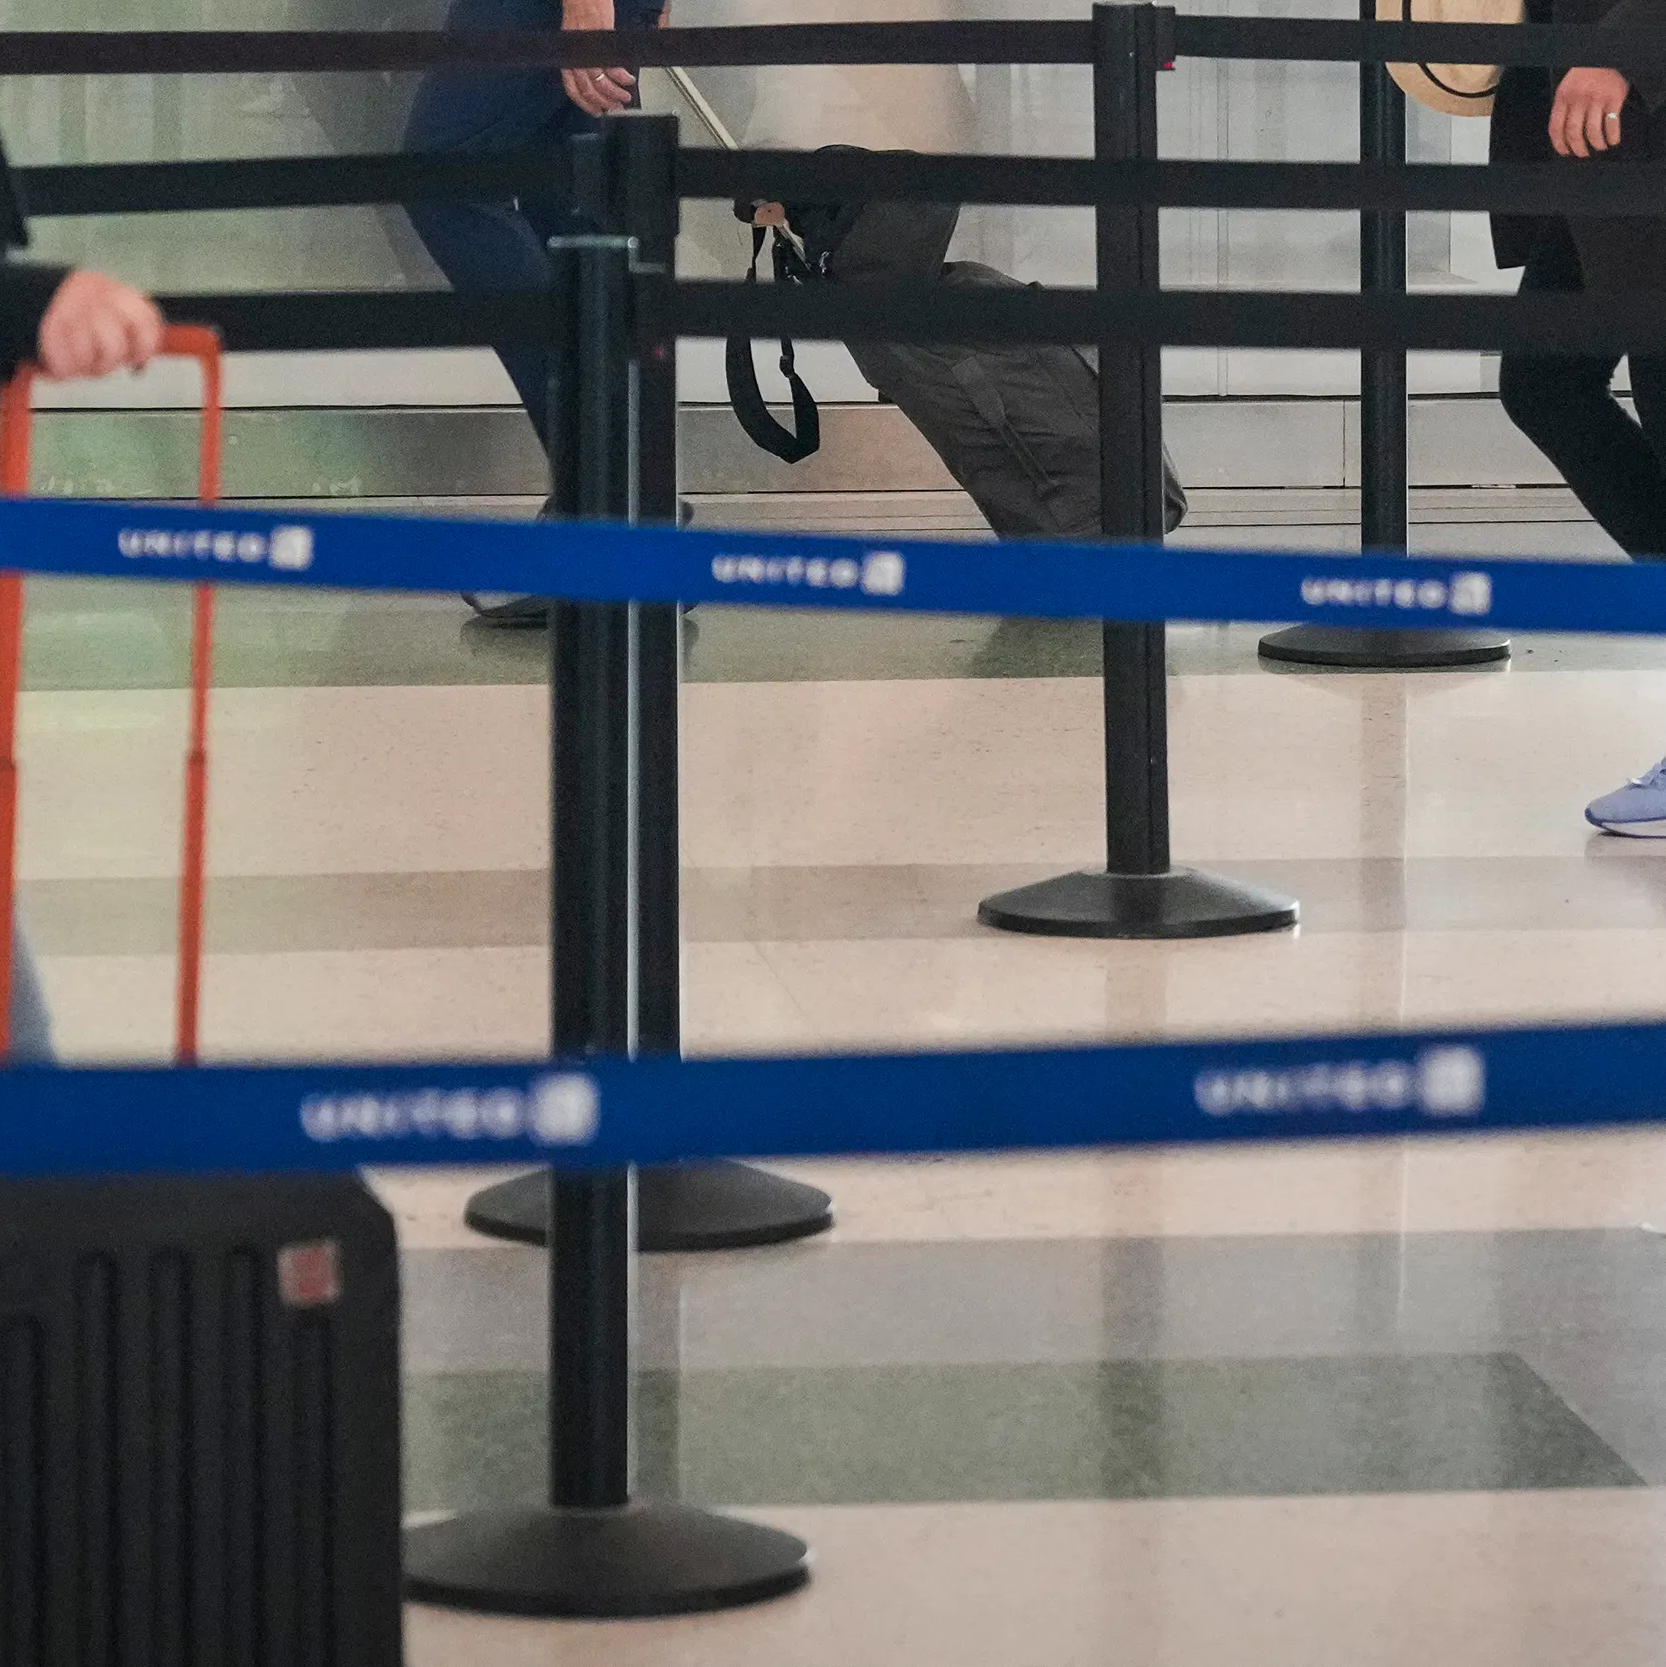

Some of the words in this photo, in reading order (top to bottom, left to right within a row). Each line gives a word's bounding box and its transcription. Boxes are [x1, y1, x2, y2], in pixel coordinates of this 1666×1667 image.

[118, 529, 267, 563] UNITED
[712, 556, 858, 589] UNITED
[1300, 577, 1446, 609] UNITED
